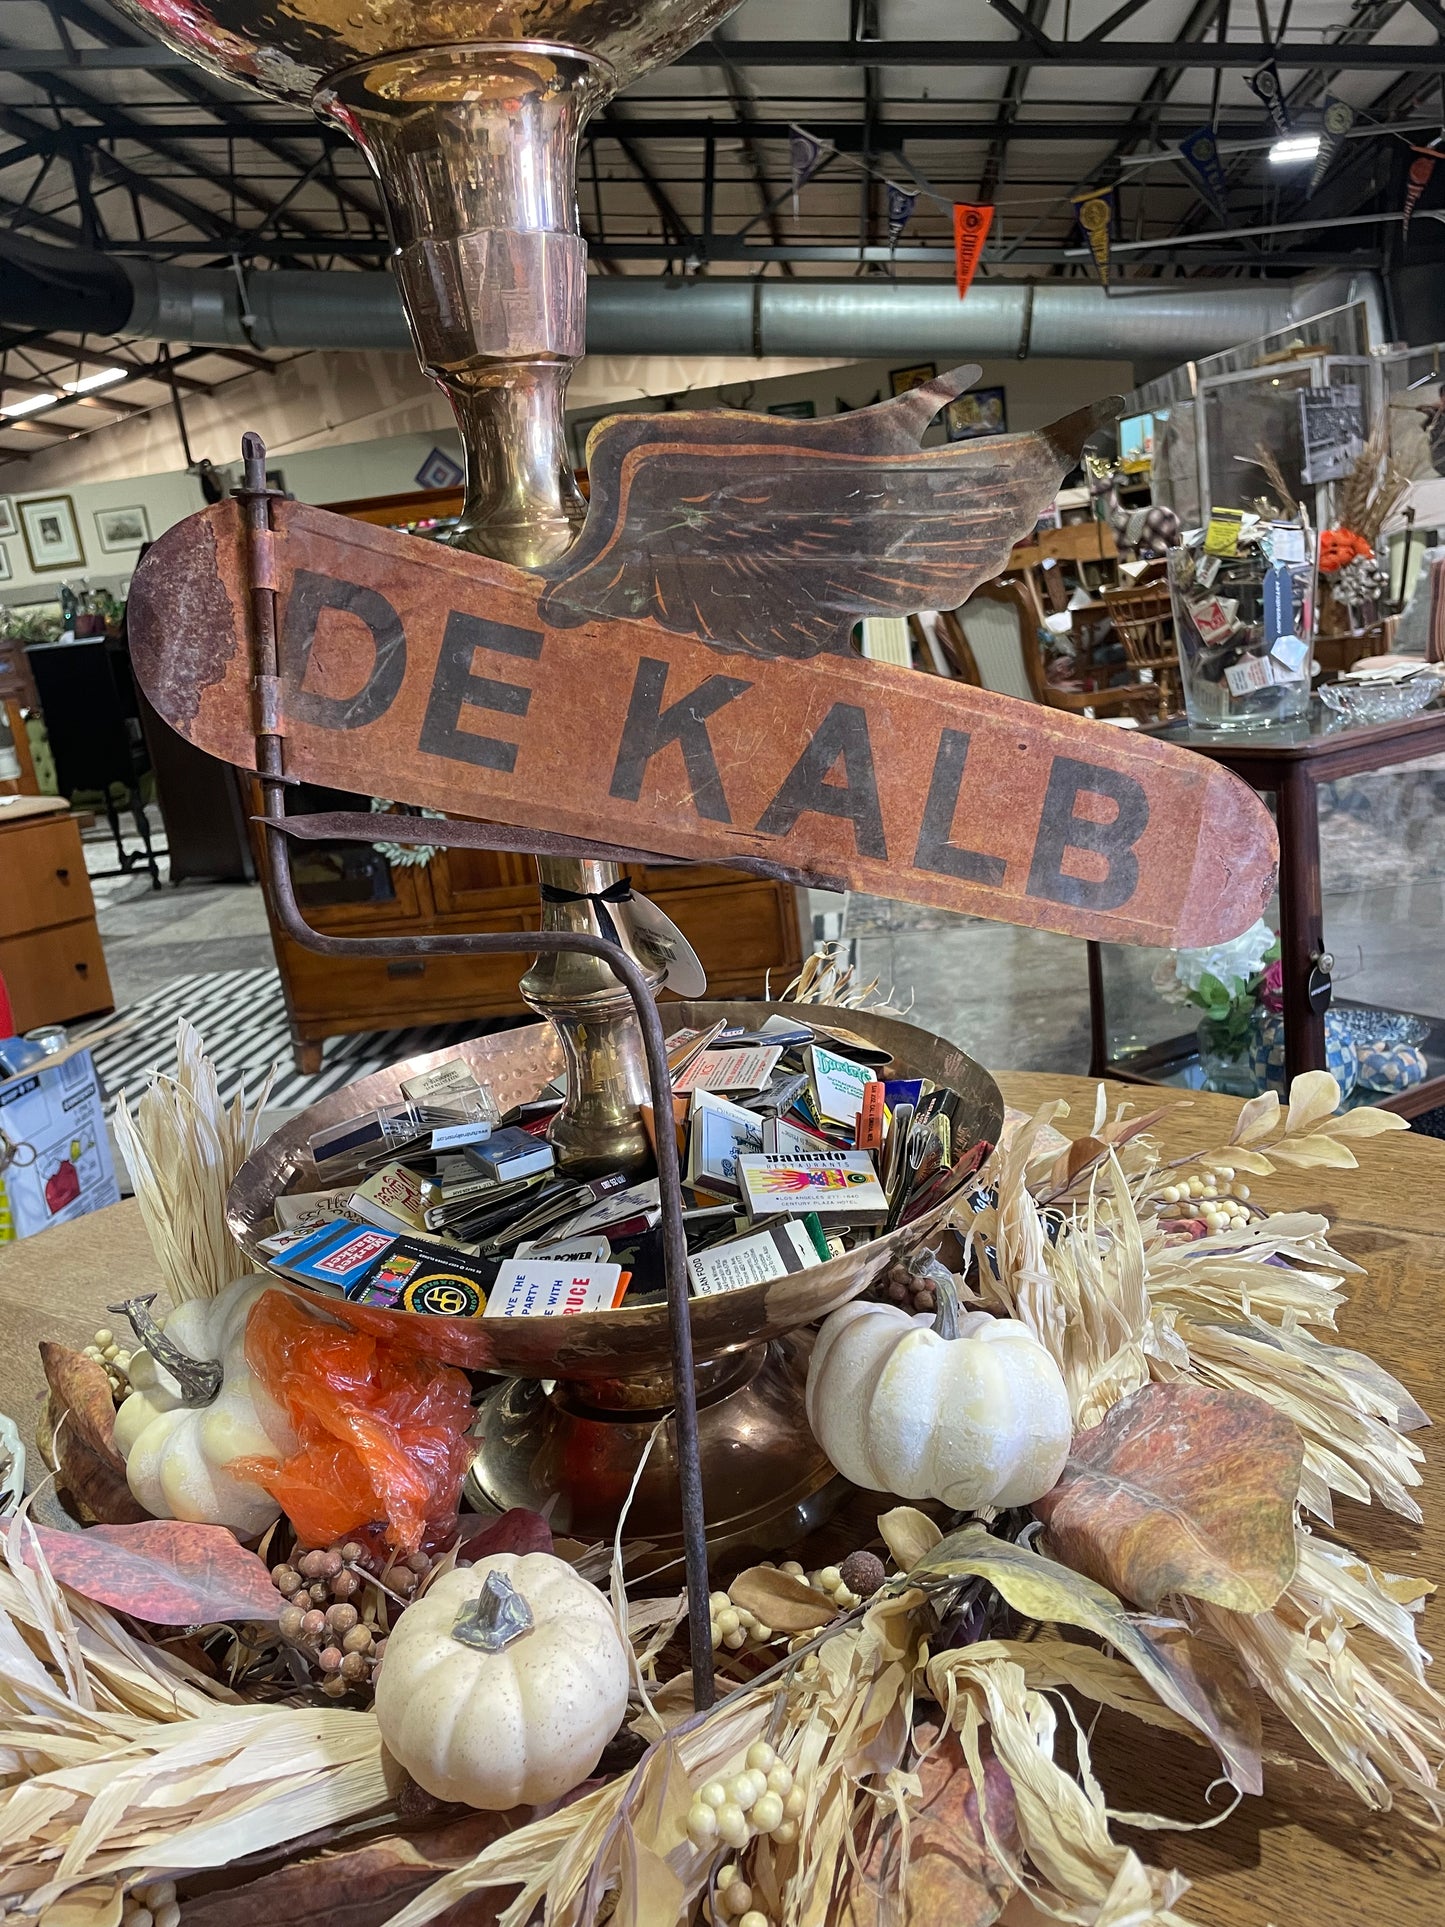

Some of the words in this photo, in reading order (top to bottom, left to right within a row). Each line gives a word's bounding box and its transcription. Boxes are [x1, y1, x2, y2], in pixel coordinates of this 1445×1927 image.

[283, 569, 545, 773] DE
[609, 656, 1150, 910] KALB
[765, 1150, 847, 1163] yamato
[766, 1161, 850, 1169] RESTAURANTS
[324, 1233, 375, 1270] Basket
[337, 1237, 388, 1271] Market
[692, 1257, 705, 1276] FOOD
[504, 1297, 518, 1317] AVE
[512, 1273, 527, 1294] THE
[522, 1283, 540, 1315] PARTY
[548, 1280, 564, 1304] WITH
[562, 1277, 591, 1316] RUCE
